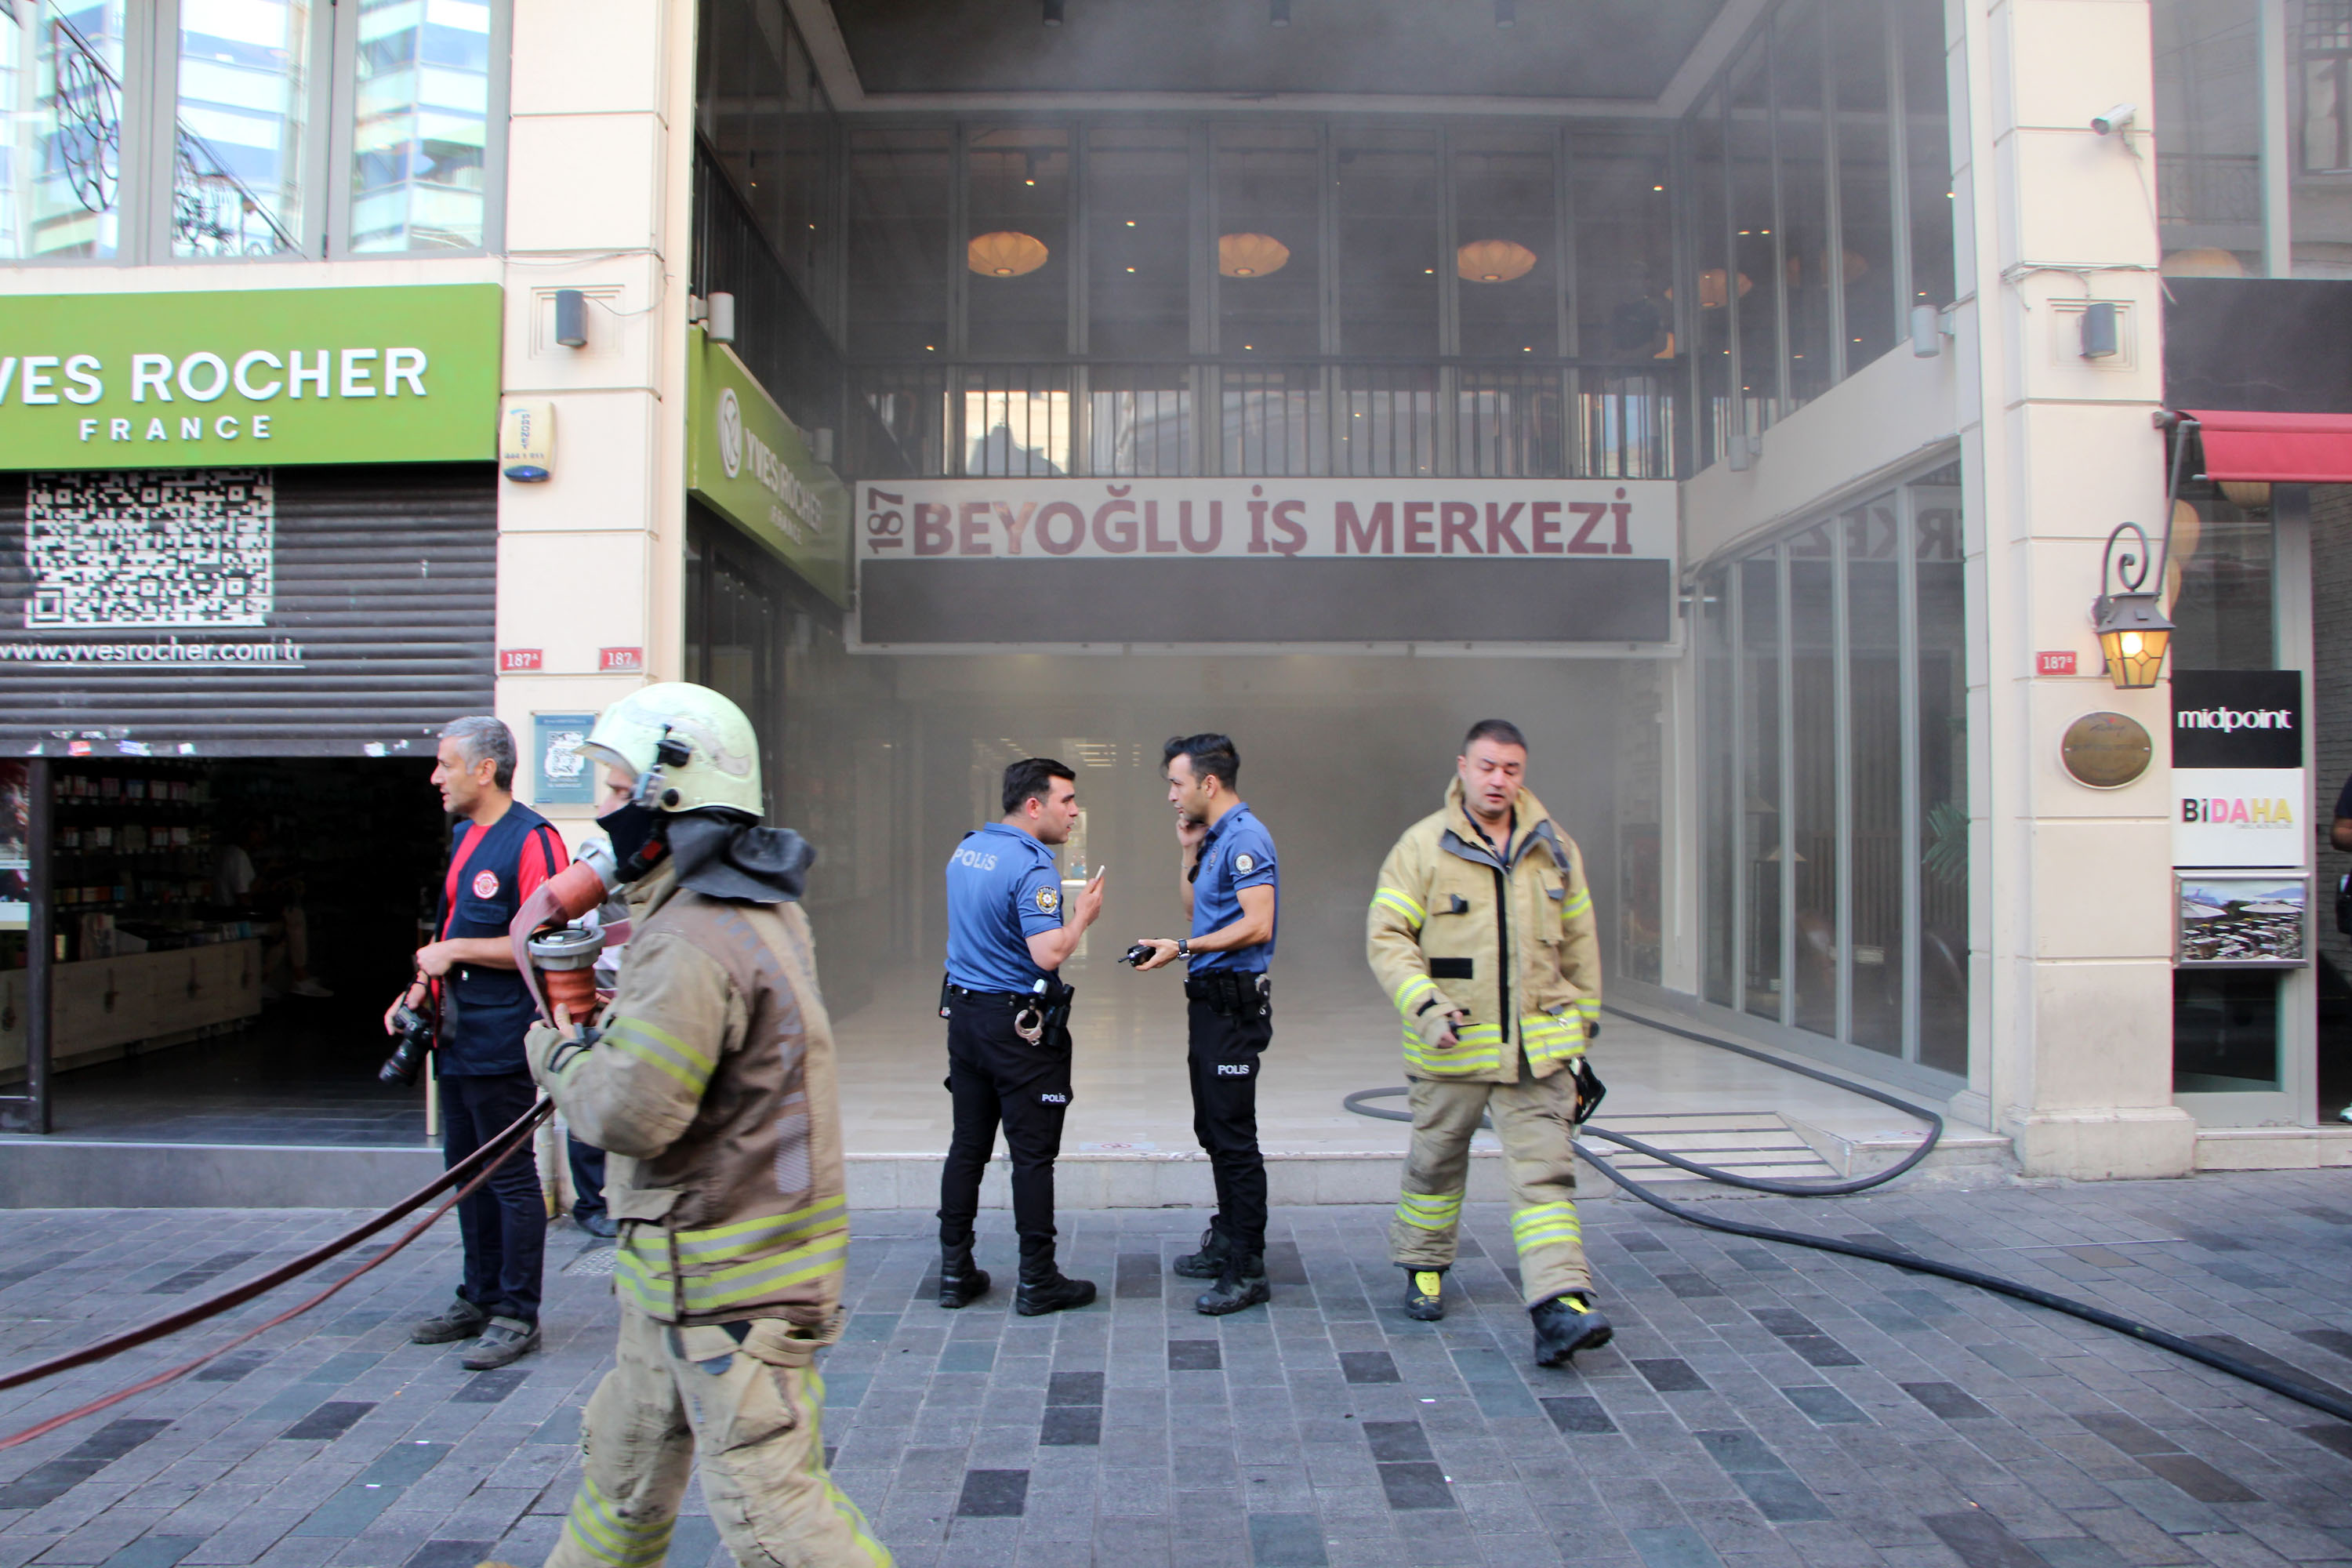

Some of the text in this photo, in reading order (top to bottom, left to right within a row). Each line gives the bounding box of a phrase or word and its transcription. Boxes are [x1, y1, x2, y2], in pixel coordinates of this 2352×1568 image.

[132, 347, 428, 402] ROCHER
[79, 416, 273, 441] FRANCE
[745, 427, 779, 493] YVES
[867, 487, 904, 554] 187
[913, 485, 1633, 557] BEYOĞLU İŞ MERKEZİ
[2177, 706, 2293, 733] midpoint
